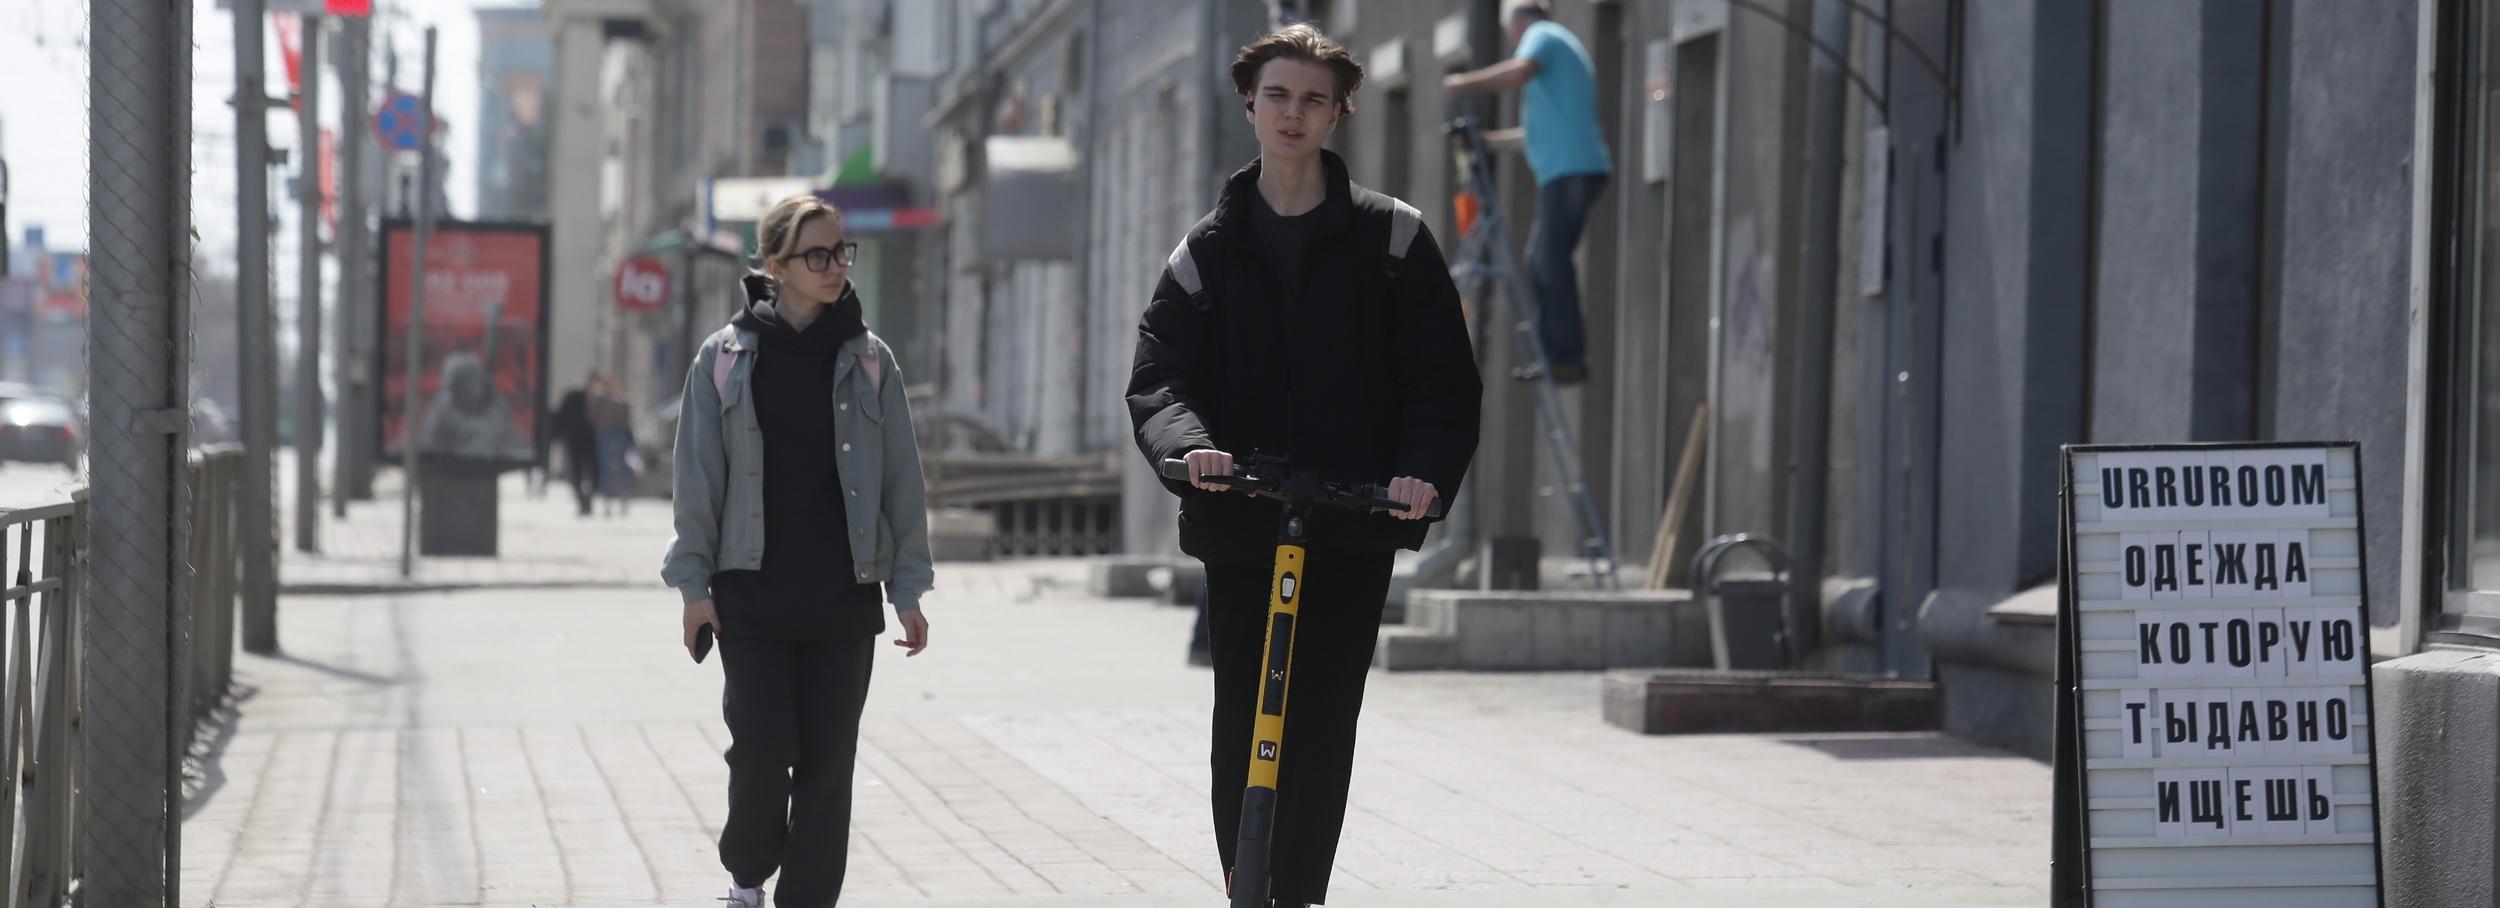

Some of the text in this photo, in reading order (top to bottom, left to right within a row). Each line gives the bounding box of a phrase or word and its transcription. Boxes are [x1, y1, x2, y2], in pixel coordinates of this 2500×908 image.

[2102, 464, 2325, 508] URRUROOM
[2126, 542, 2306, 591] ОДЕЖДА
[2140, 619, 2353, 667] КОТОРУЮ
[1260, 743, 1276, 758] W
[2158, 779, 2329, 829] ИЩЕШЬ
